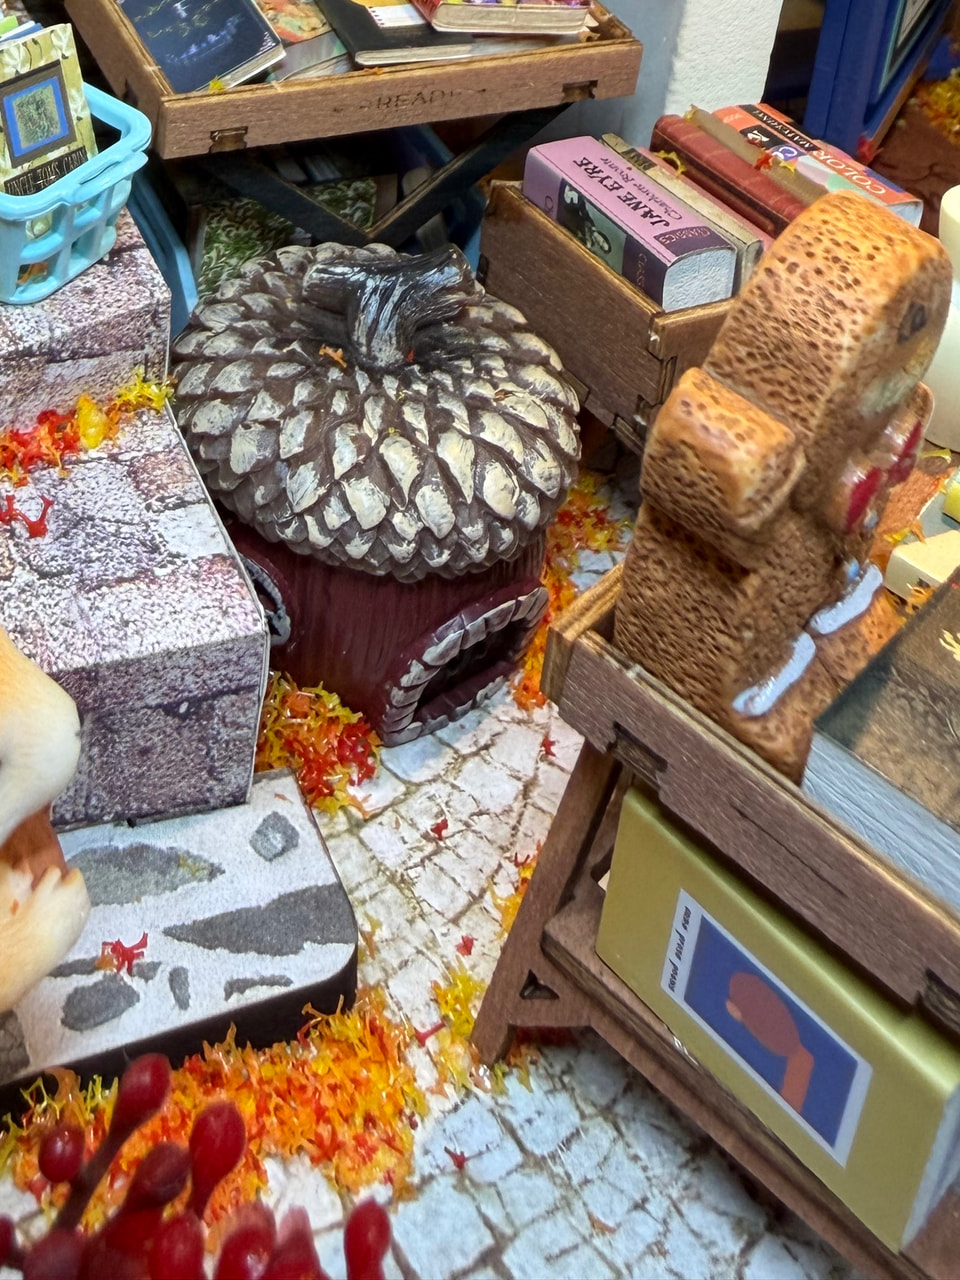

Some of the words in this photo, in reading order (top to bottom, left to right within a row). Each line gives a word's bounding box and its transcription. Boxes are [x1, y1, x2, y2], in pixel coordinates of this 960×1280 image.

[6, 172, 34, 197] UNCLE
[62, 148, 88, 174] CABIN
[573, 156, 625, 193] EYRE
[812, 149, 886, 195] COLOR
[617, 190, 671, 228] JANE
